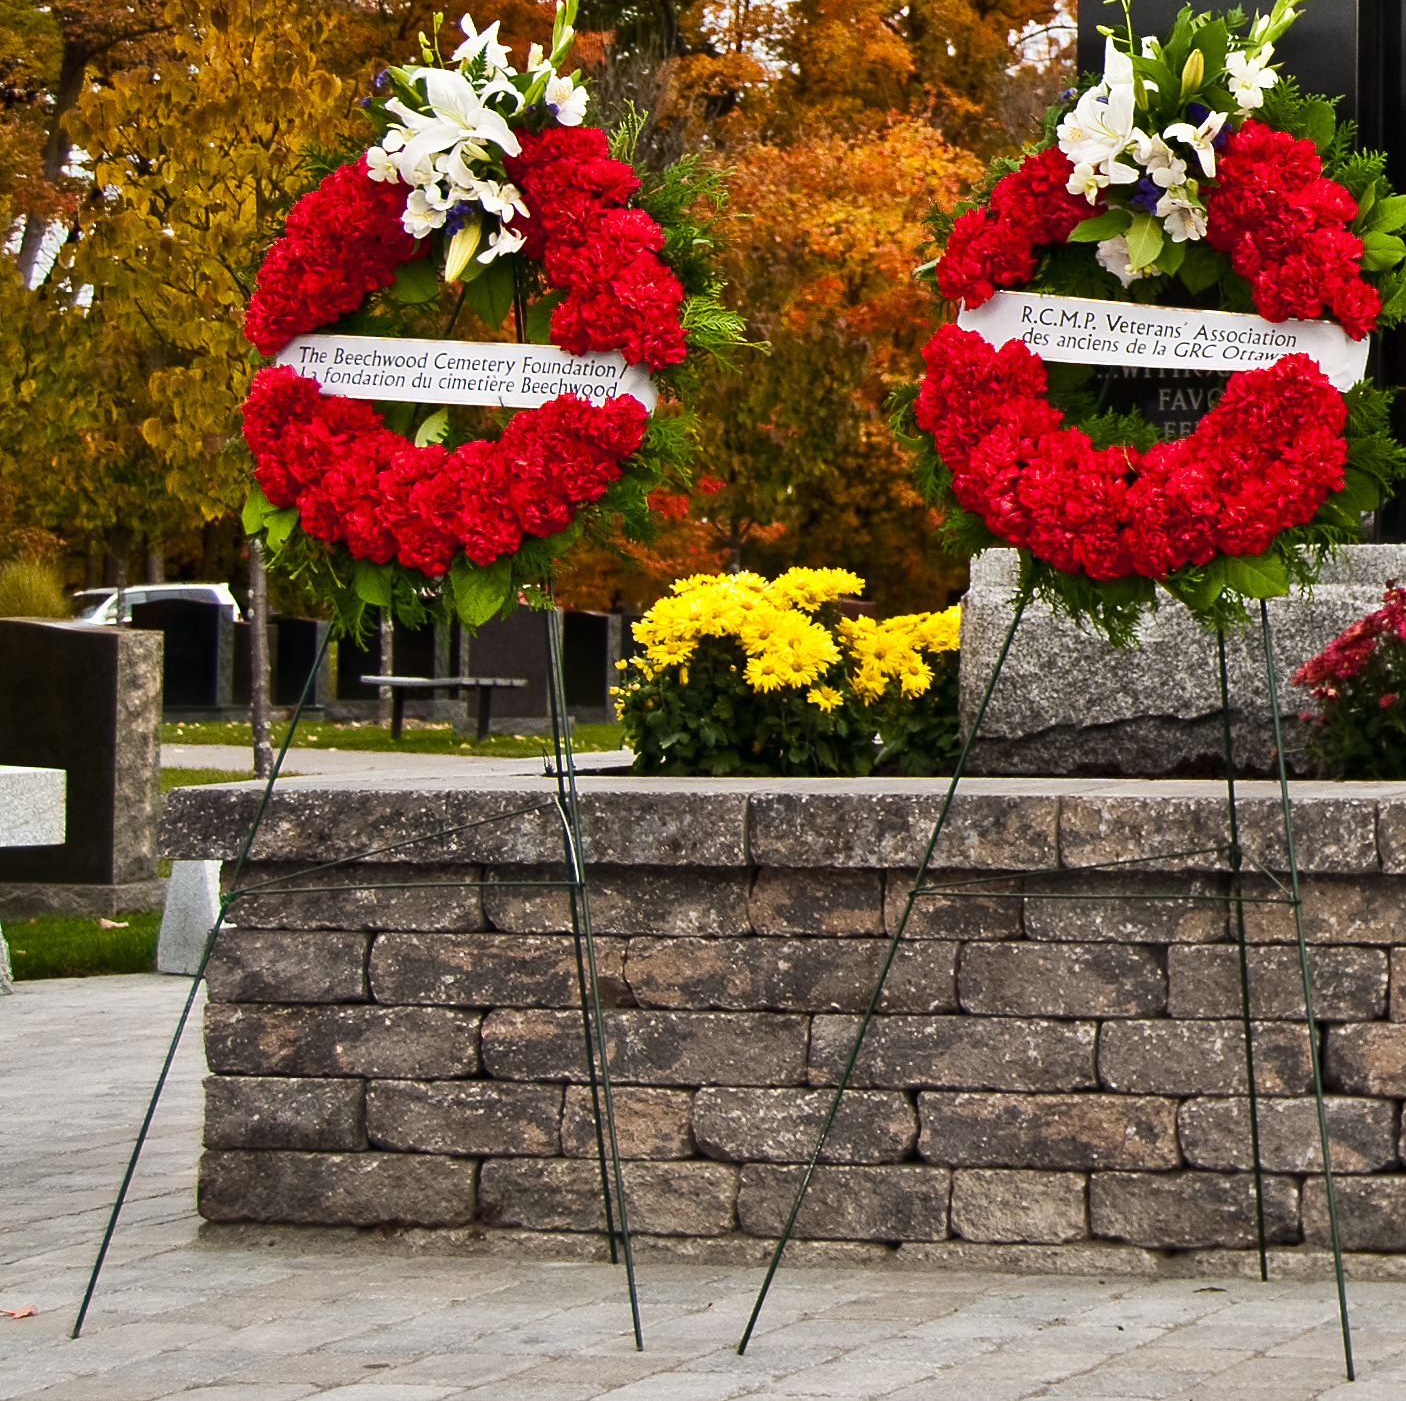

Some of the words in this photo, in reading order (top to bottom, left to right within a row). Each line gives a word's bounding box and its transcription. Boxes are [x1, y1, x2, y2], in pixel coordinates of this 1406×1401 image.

[1021, 305, 1096, 331] R.C.M.P.
[1195, 324, 1297, 349] Association
[299, 346, 327, 364] The
[333, 347, 427, 369] Beechwood
[433, 352, 515, 377] Cemetery
[1022, 327, 1050, 346] des
[1056, 334, 1119, 353] anciens
[1126, 338, 1147, 355] de
[1152, 340, 1166, 356] la
[1174, 342, 1216, 359] GRC
[1222, 345, 1284, 362] Ottaw
[323, 366, 405, 387] fondation
[411, 371, 432, 389] du
[438, 374, 515, 394] cimetière
[520, 377, 618, 399] Beechwood
